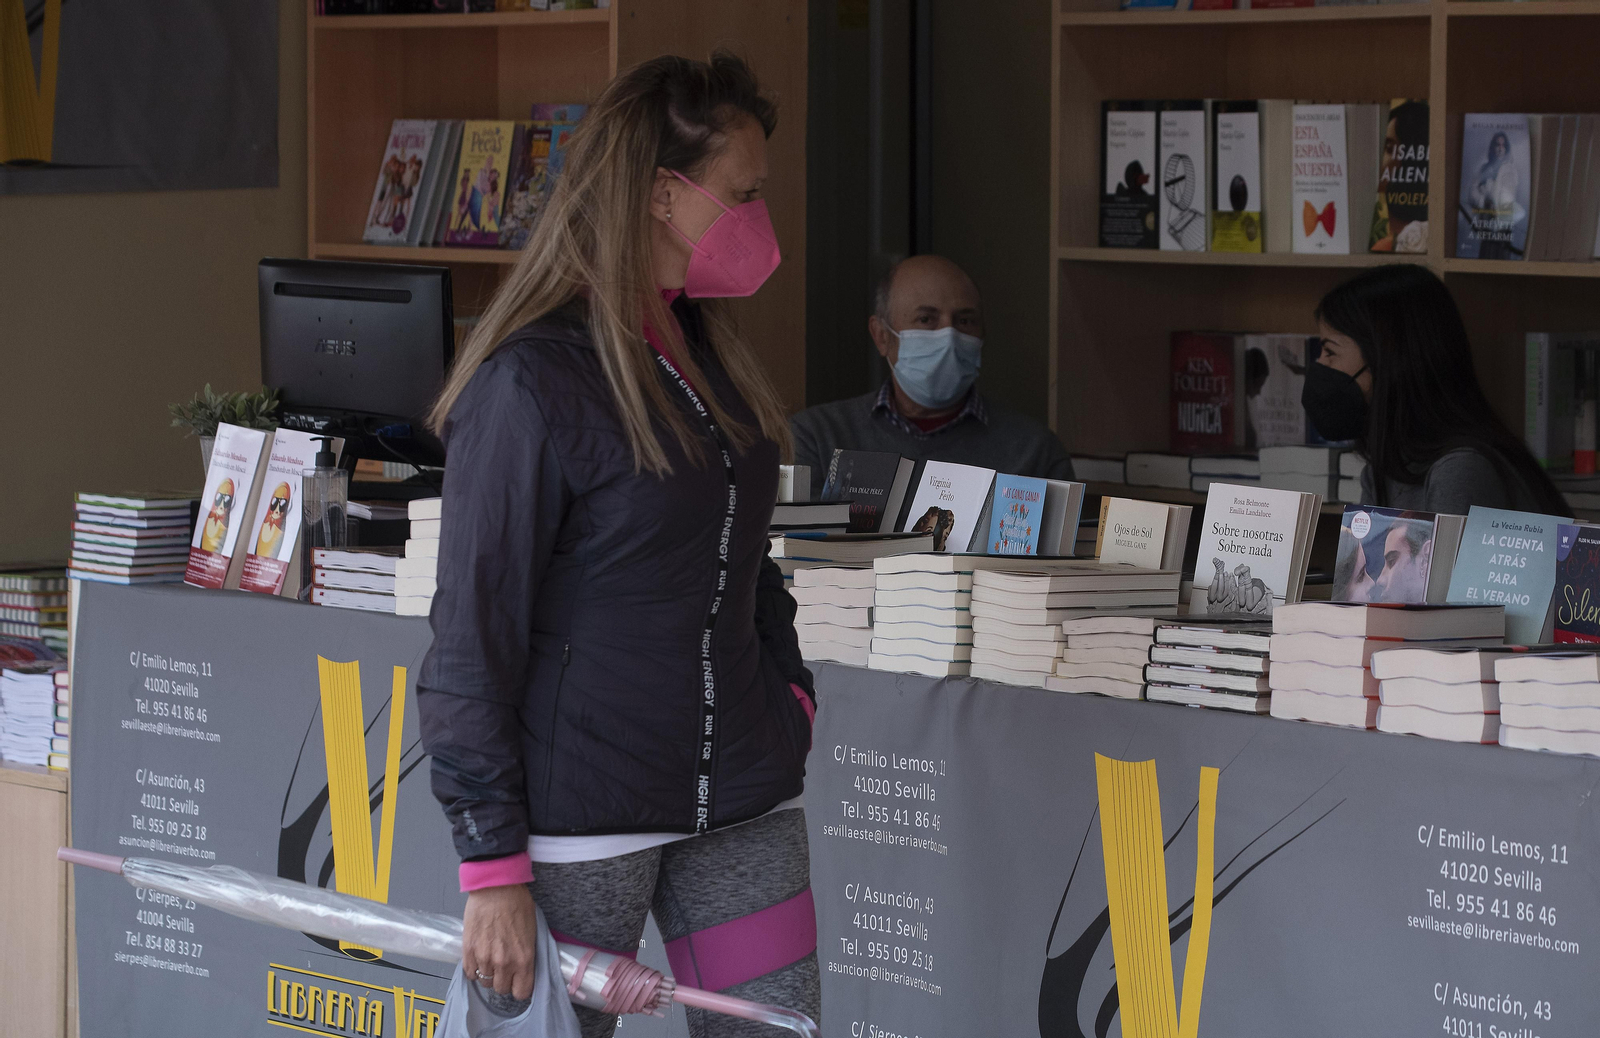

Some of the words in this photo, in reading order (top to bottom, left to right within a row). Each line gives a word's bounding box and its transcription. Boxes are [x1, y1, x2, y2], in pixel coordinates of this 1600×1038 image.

[1294, 126, 1320, 140] ESTA
[1294, 141, 1333, 158] ESPAÑA
[1294, 162, 1343, 177] NUESTRA
[1380, 166, 1429, 183] ALLEN
[314, 338, 357, 356] ASUS
[1187, 357, 1214, 374] KEN
[1173, 372, 1229, 395] FOLLETT
[1177, 402, 1223, 434] NUNCA
[929, 475, 952, 489] Virginia
[727, 485, 737, 514] HIGH
[939, 490, 955, 502] Feito
[1233, 497, 1244, 506] Rosa
[1245, 499, 1270, 508] Belmonte
[1229, 506, 1244, 515] Emilia
[1245, 508, 1271, 518] Landaluce
[719, 516, 733, 562] ENERGY
[1114, 522, 1130, 537] Ojos
[1131, 524, 1140, 537] de
[1141, 526, 1153, 539] Sol
[1211, 521, 1241, 538] Sobre
[1242, 527, 1284, 543] nosotras
[1491, 520, 1500, 529] La
[1501, 521, 1522, 532] Vecina
[1523, 524, 1544, 534] Rubia
[1115, 538, 1133, 548] MIGUEL
[1133, 541, 1148, 550] GANE
[1217, 539, 1247, 555] Sobre
[1248, 544, 1273, 558] nada
[1481, 533, 1496, 545] LA
[1498, 535, 1544, 552] CUENTA
[1488, 551, 1527, 568] ATRÁS
[718, 570, 727, 590] RUN
[1487, 571, 1518, 586] PARA
[710, 597, 721, 614] FOR
[1466, 587, 1480, 600] EL
[1482, 588, 1530, 606] VERANO
[701, 628, 712, 658] HIGH
[130, 651, 140, 669] C/
[142, 652, 167, 670] Emilio
[169, 657, 199, 677] Lemos,
[201, 661, 212, 677] 11
[144, 676, 170, 694] 41020
[171, 680, 199, 698] Sevilla
[702, 660, 715, 707] ENERGY
[135, 698, 151, 714] Tel.
[153, 701, 169, 717] 955
[171, 704, 182, 719] 41
[184, 705, 194, 721] 86
[196, 708, 208, 723] 46
[121, 718, 221, 743] sevillaeste@libreriaverbo.com
[704, 714, 713, 735] RUN
[702, 741, 712, 760] FOR
[834, 745, 847, 764] C/
[850, 747, 887, 768] Emilio
[892, 753, 938, 777] Lemos,
[940, 759, 946, 777] 11
[135, 768, 147, 786] C/
[148, 770, 192, 793] Asunción,
[194, 778, 205, 793] 43
[698, 775, 709, 805] HIGH
[853, 775, 890, 796] 41020
[894, 781, 936, 802] Sevilla
[140, 793, 167, 811] 41011
[169, 797, 199, 816] Sevilla
[841, 800, 864, 819] Tel.
[867, 804, 889, 823] 955
[893, 808, 910, 826] 41
[915, 810, 930, 828] 86
[931, 813, 941, 832] 46
[131, 814, 147, 831] Tel.
[148, 817, 164, 834] 955
[166, 820, 179, 836] 09
[180, 823, 192, 839] 25
[194, 825, 207, 841] 18
[119, 835, 216, 861] asuncion@libreriaverbo.com
[823, 824, 948, 856] sevillaeste@libreriaverbo.com
[1418, 824, 1434, 848] C/
[1439, 827, 1486, 853] Emilio
[1491, 835, 1545, 865] Lemos,
[1550, 843, 1569, 865] 11
[1440, 859, 1489, 884] 41020
[1494, 866, 1542, 893] Sevilla
[135, 887, 147, 904] C/
[148, 888, 183, 910] Sierpes,
[845, 883, 860, 904] C/
[863, 886, 923, 915] Asunción,
[924, 897, 934, 915] 43
[1426, 888, 1451, 911] Tel.
[1456, 893, 1485, 915] 955
[1490, 898, 1511, 919] 41
[1516, 901, 1535, 923] 86
[1538, 905, 1557, 927] 46
[136, 909, 164, 928] 41004
[165, 914, 195, 934] Sevilla
[853, 912, 892, 934] 41011
[896, 918, 929, 942] Sevilla
[125, 930, 144, 948] Tel.
[145, 934, 162, 951] 854
[163, 937, 176, 954] 88
[178, 940, 189, 956] 33
[191, 943, 203, 959] 27
[1407, 914, 1580, 955] sevillaeste@libreriaverbo.com
[114, 950, 210, 978] sierpes@libreriaverbo.com
[840, 937, 863, 957] Tel.
[868, 941, 890, 961] 955
[893, 946, 908, 964] 09
[912, 949, 923, 968] 25
[924, 953, 934, 972] 18
[828, 960, 942, 996] asuncion@libreriaverbo.com
[266, 970, 385, 1038] LIBRERÍA
[1434, 982, 1449, 1005] C/
[1453, 986, 1528, 1020] Asunción,
[1533, 1000, 1552, 1021] 43
[851, 1021, 865, 1038] C/
[869, 1024, 908, 1038] Sier
[1442, 1015, 1482, 1038] 41011
[1489, 1024, 1541, 1038] Sevill
